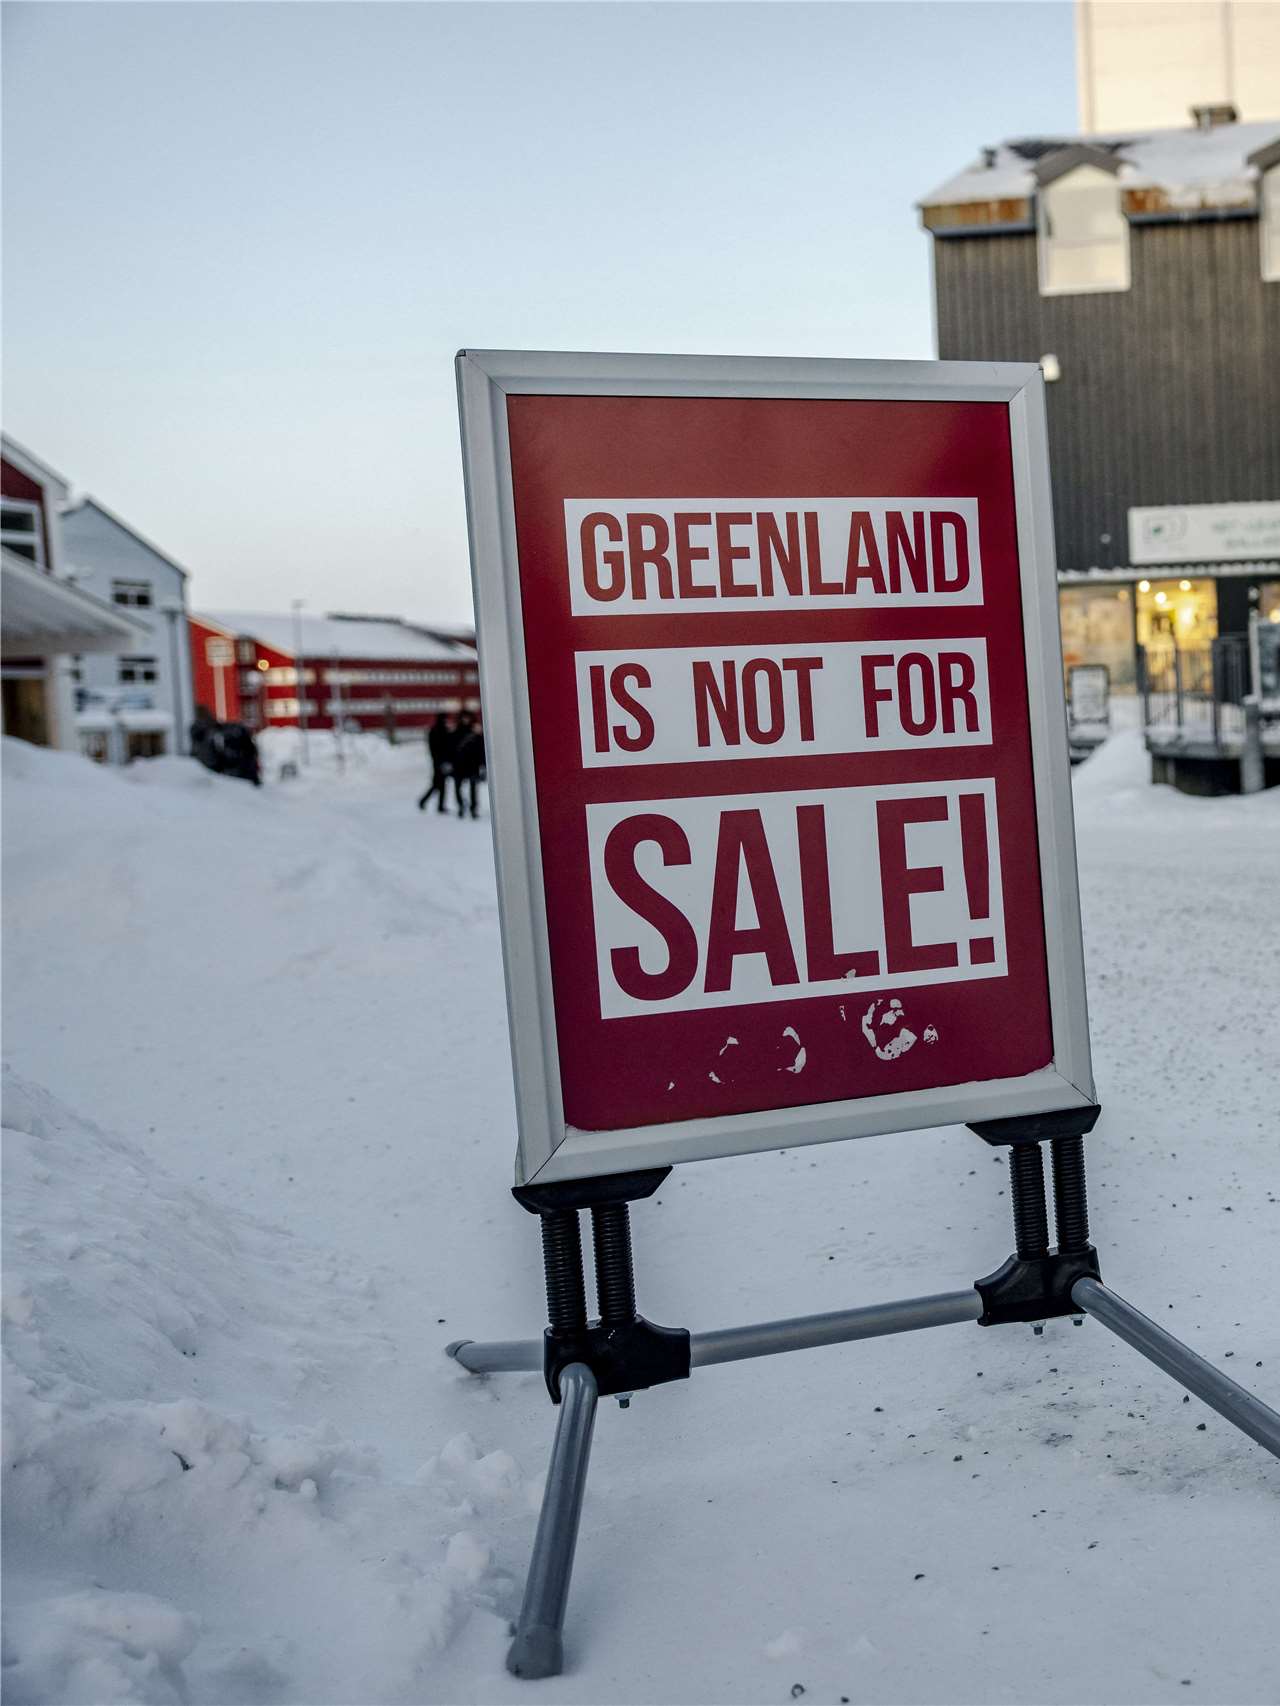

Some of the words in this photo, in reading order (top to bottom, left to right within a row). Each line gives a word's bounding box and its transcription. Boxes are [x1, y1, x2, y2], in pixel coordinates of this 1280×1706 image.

[579, 510, 971, 602] GREENLAND
[589, 662, 655, 753] IS
[693, 656, 823, 748] NOT
[862, 651, 980, 738] FOR
[602, 793, 996, 1001] SALE!
